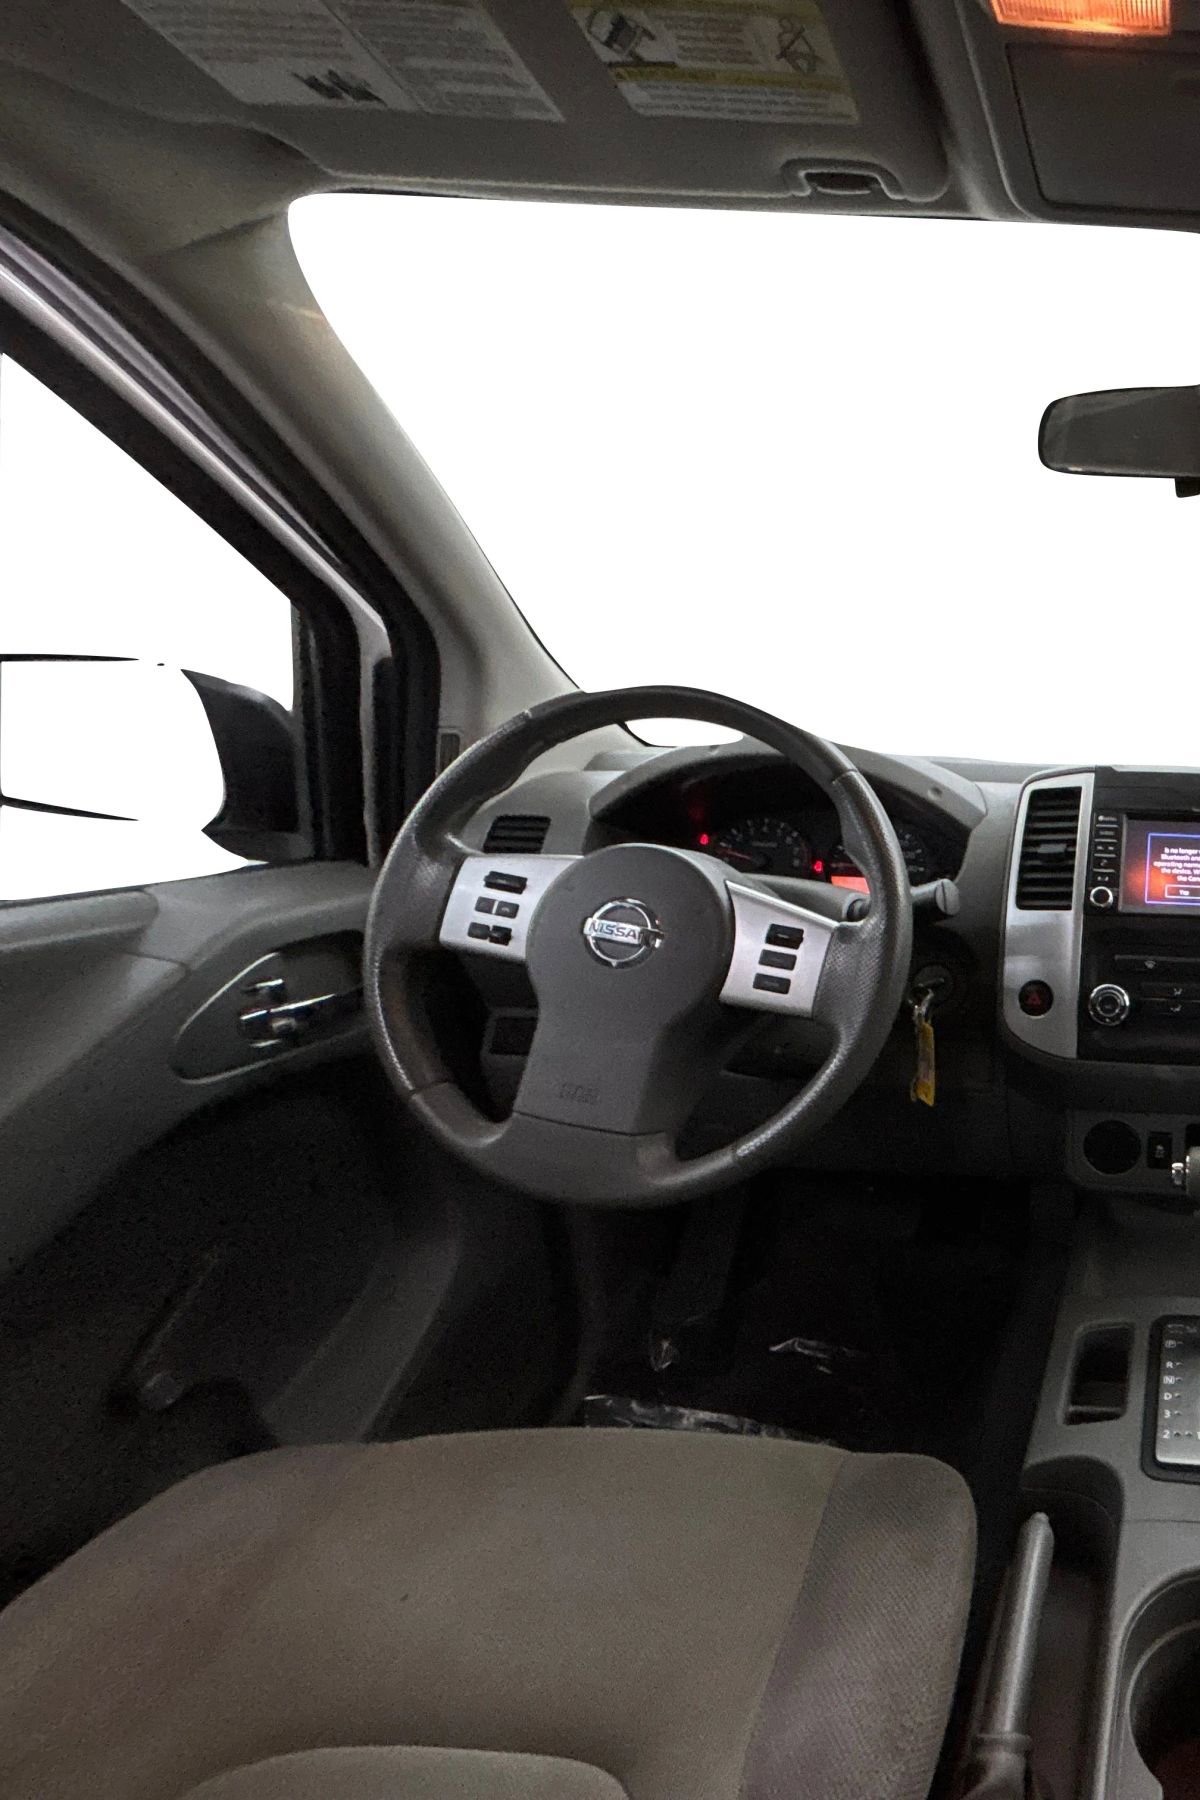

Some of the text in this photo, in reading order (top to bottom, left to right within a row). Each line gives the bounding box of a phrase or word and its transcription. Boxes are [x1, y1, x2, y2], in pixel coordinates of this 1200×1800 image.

[1166, 1361, 1174, 1369] R
[1164, 1392, 1172, 1400] D
[1164, 1409, 1171, 1418] 3
[1162, 1429, 1170, 1439] 2
